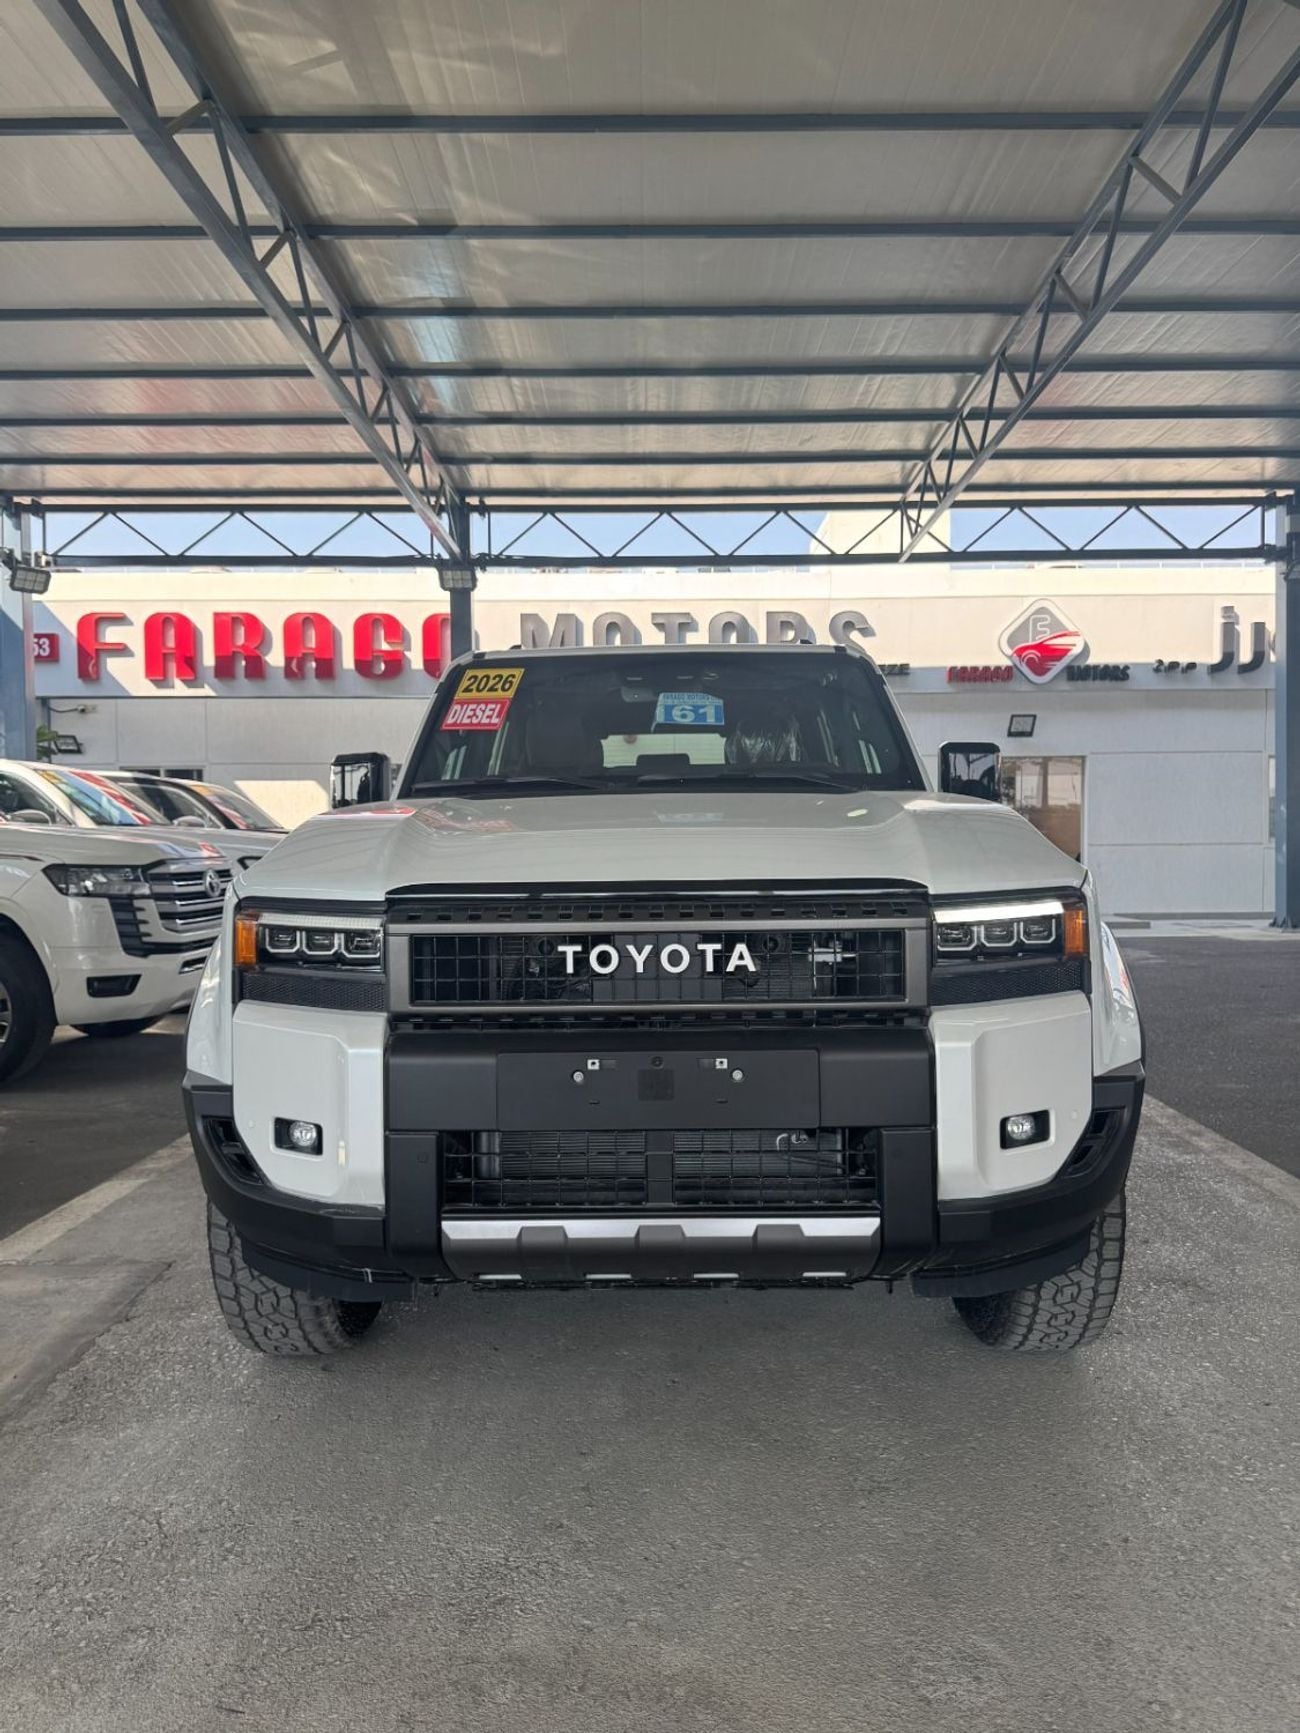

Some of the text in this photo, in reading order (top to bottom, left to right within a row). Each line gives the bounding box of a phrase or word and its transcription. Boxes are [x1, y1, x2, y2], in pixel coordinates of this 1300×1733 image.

[461, 674, 517, 693] 2026
[447, 703, 502, 724] DIESEL
[671, 705, 716, 723] 61
[557, 943, 757, 974] TOYOTA
